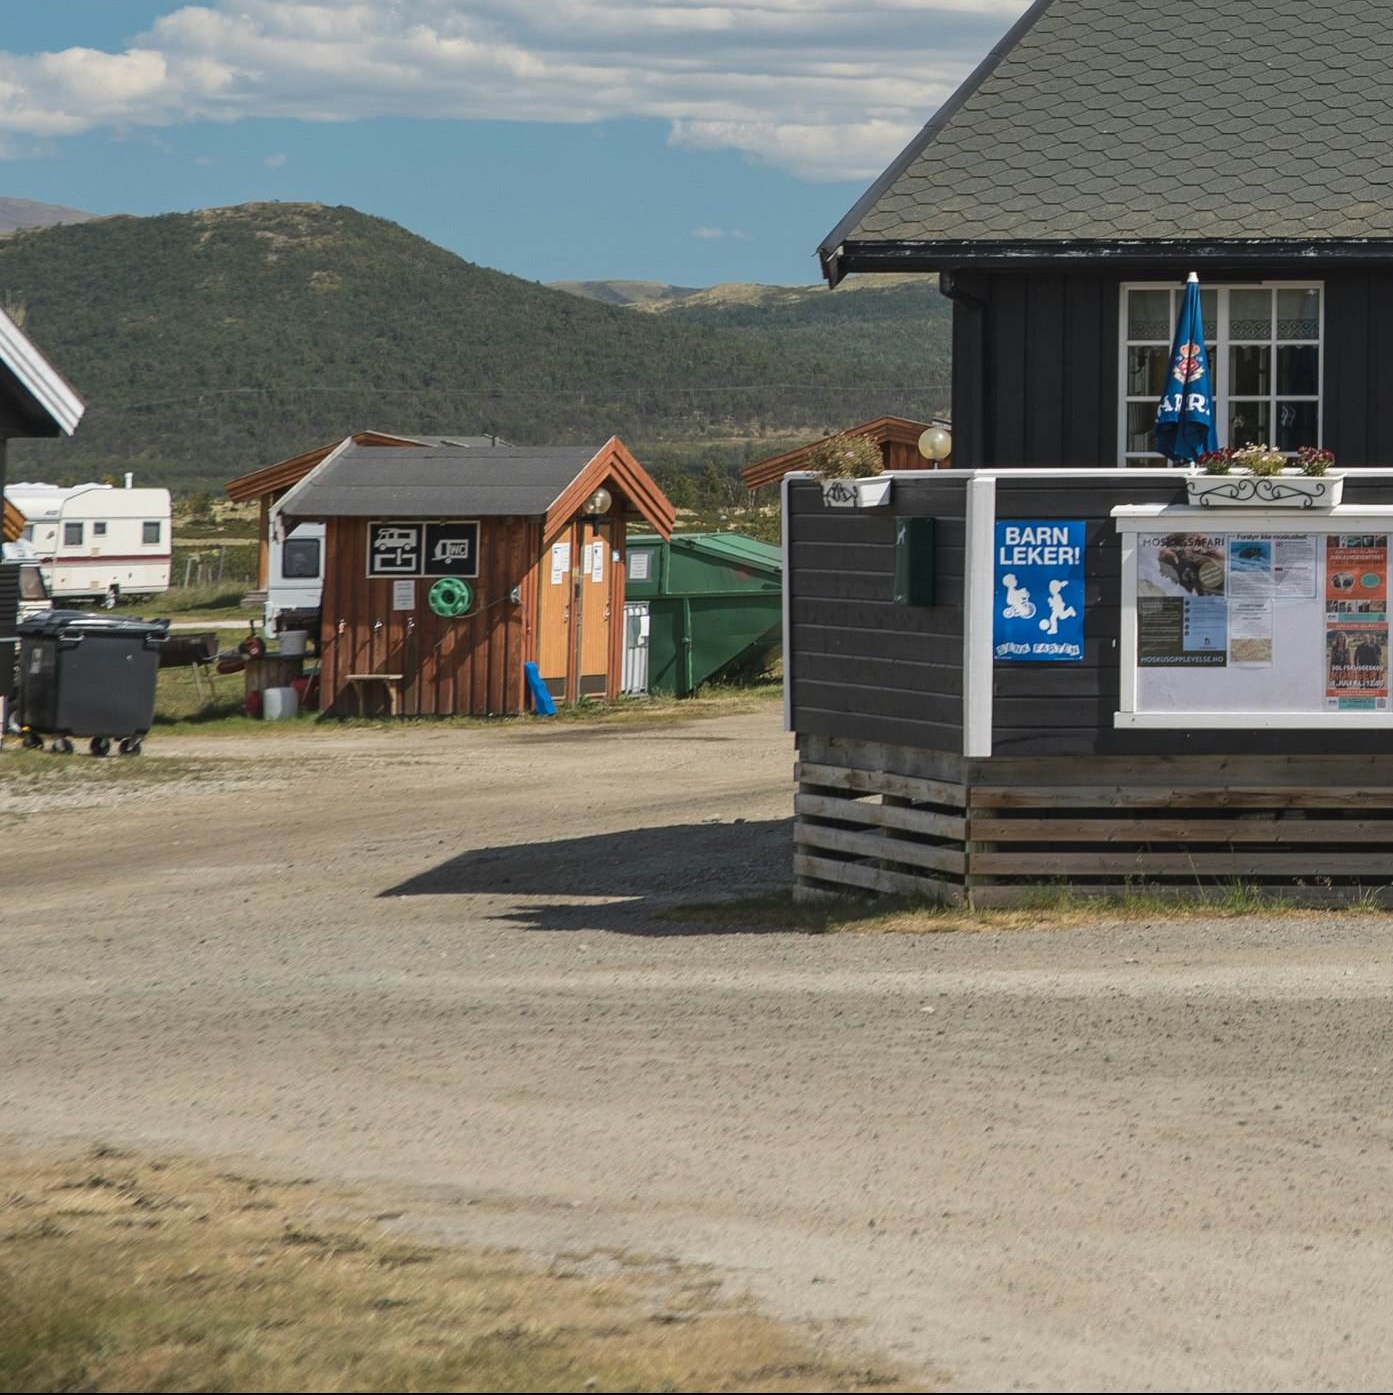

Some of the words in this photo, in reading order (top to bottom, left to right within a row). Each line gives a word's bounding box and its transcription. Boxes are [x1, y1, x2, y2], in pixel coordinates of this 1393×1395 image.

[1005, 526, 1069, 545] BARN
[450, 542, 466, 555] WC
[1000, 546, 1080, 565] LEKER!
